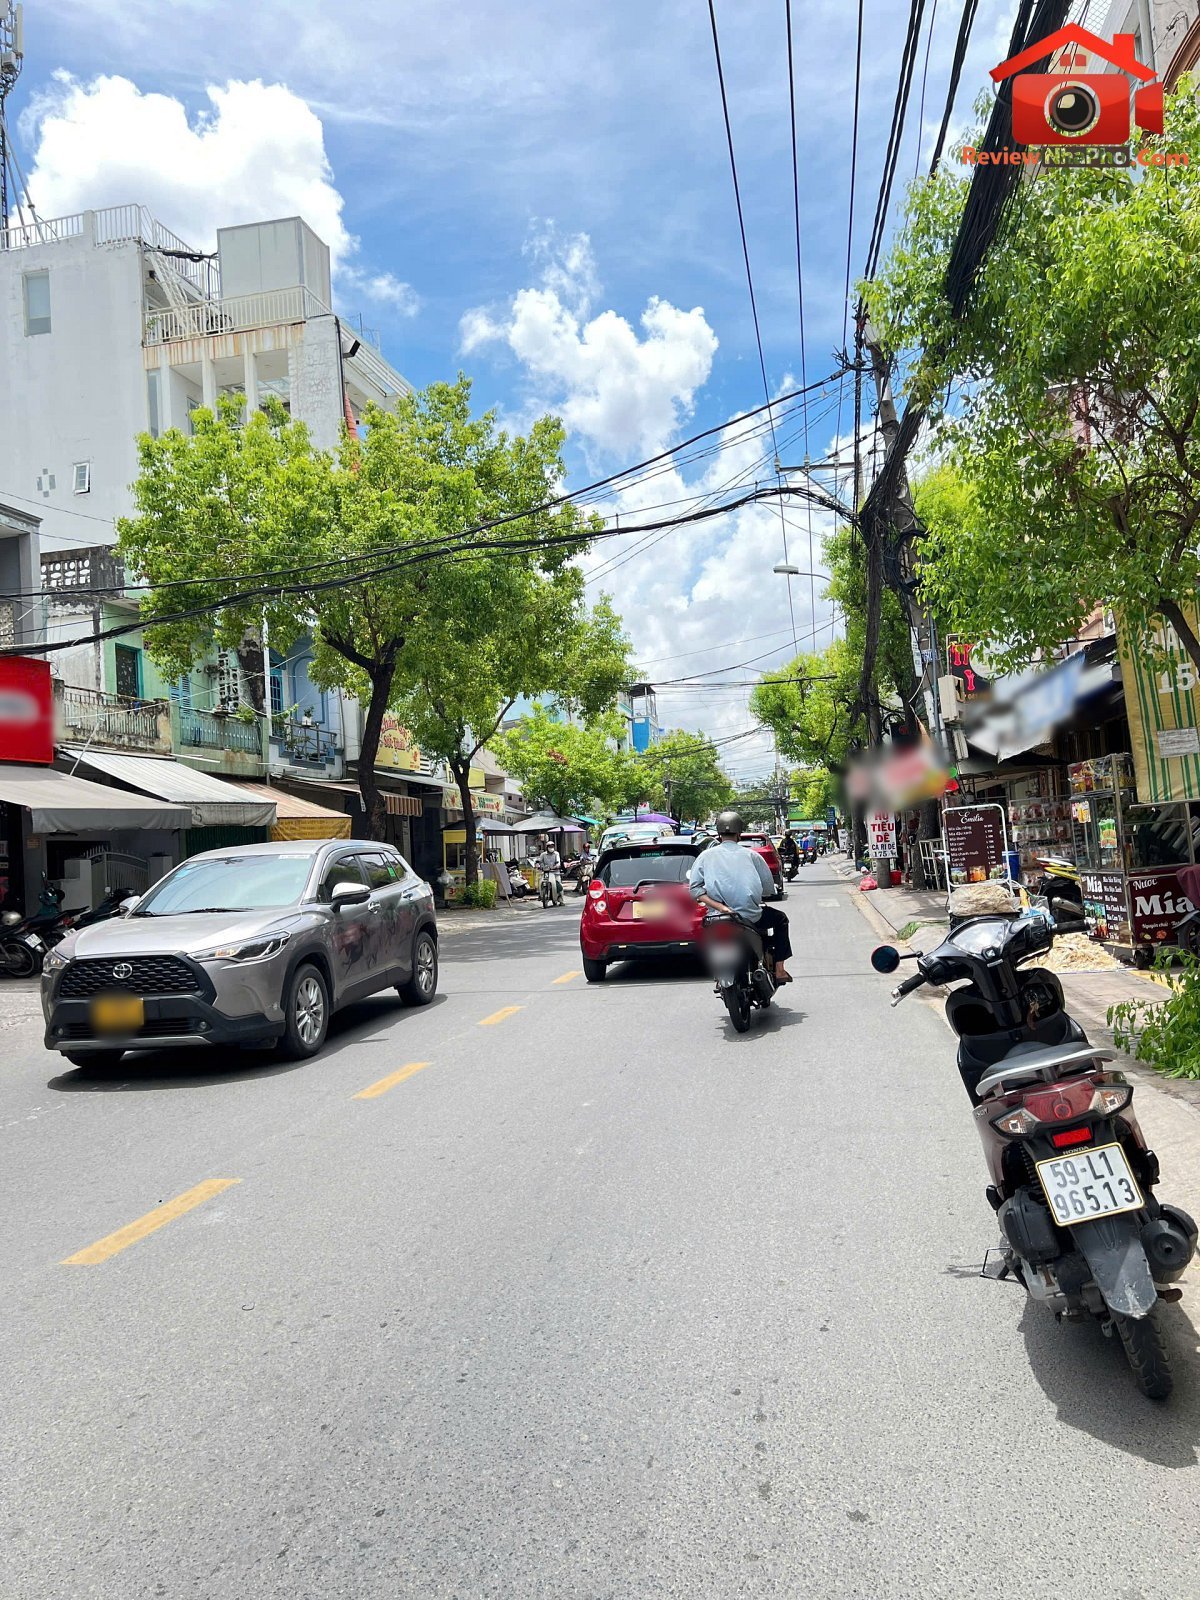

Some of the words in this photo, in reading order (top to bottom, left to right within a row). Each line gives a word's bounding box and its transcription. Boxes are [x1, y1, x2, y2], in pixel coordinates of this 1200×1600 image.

[871, 820, 895, 832] TIẾU
[876, 832, 890, 843] DÊ
[1134, 891, 1196, 917] Mía
[1050, 1151, 1115, 1189] 59-L1
[1053, 1178, 1136, 1220] 965.13
